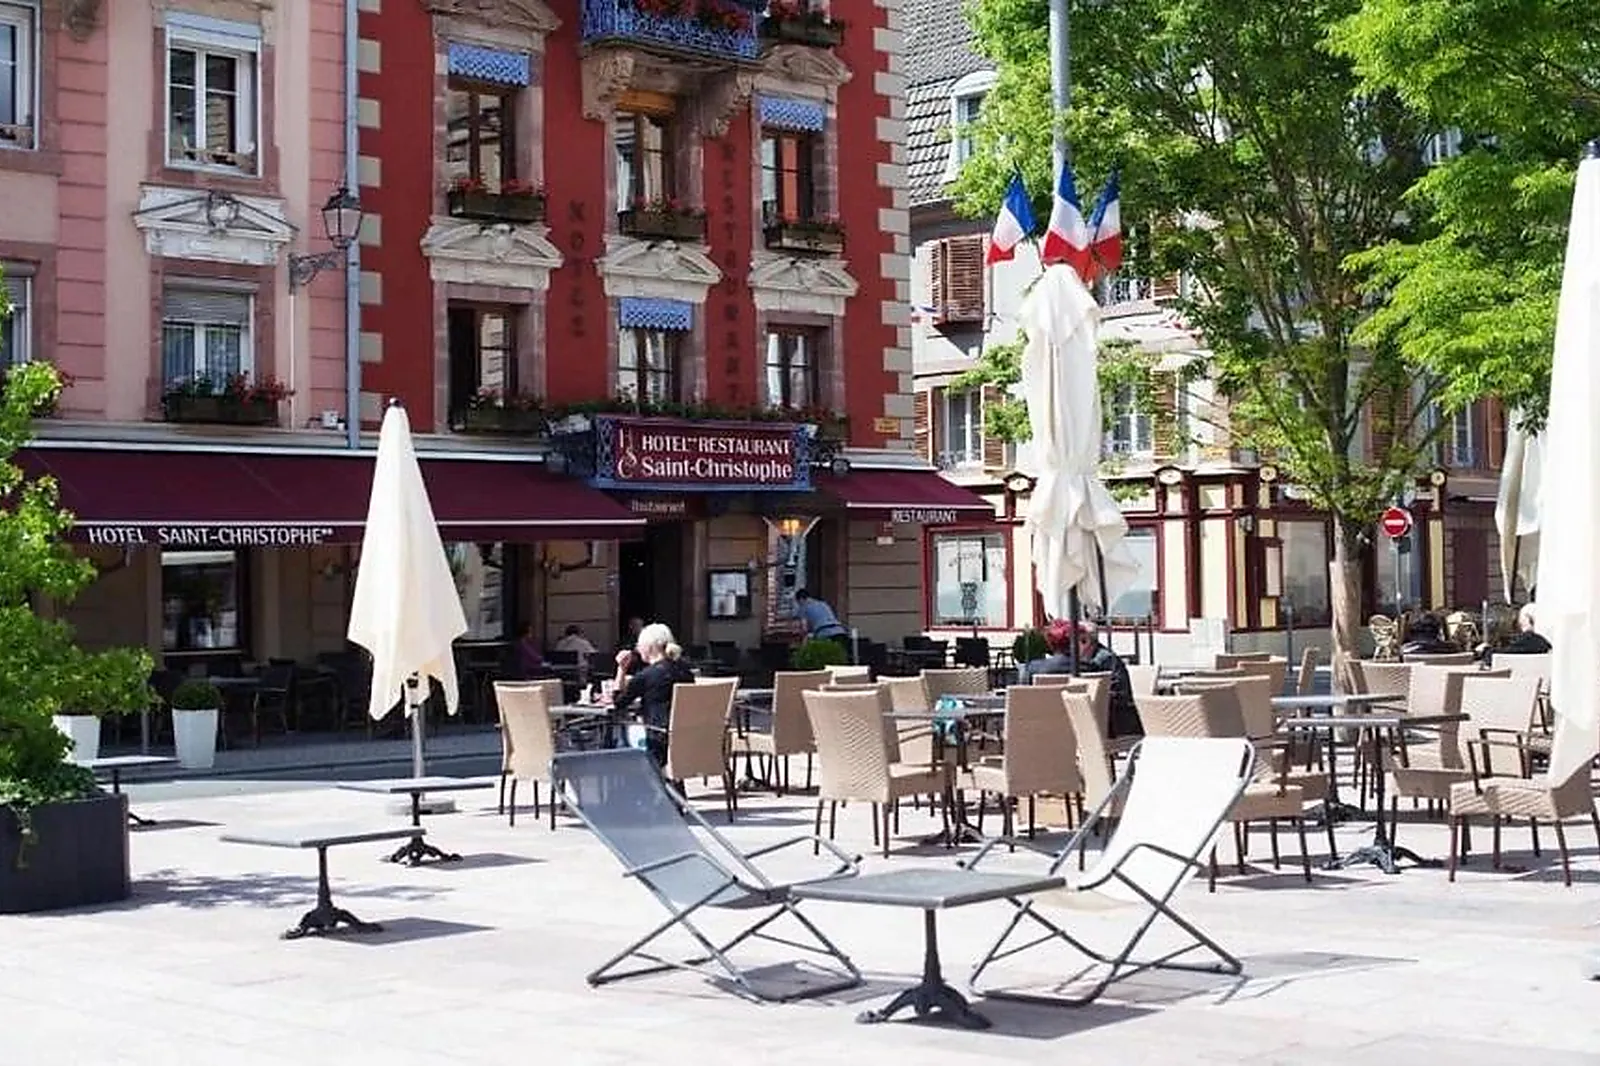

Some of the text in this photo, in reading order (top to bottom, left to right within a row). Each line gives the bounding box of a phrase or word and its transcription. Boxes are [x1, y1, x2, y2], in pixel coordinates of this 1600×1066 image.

[642, 435, 789, 455] HOTEL RESTAURANT
[641, 456, 793, 482] Saint-Christophe
[892, 509, 957, 523] RESTAURANT
[88, 527, 323, 545] HOTEL SAINT-CHRISTOPHE
